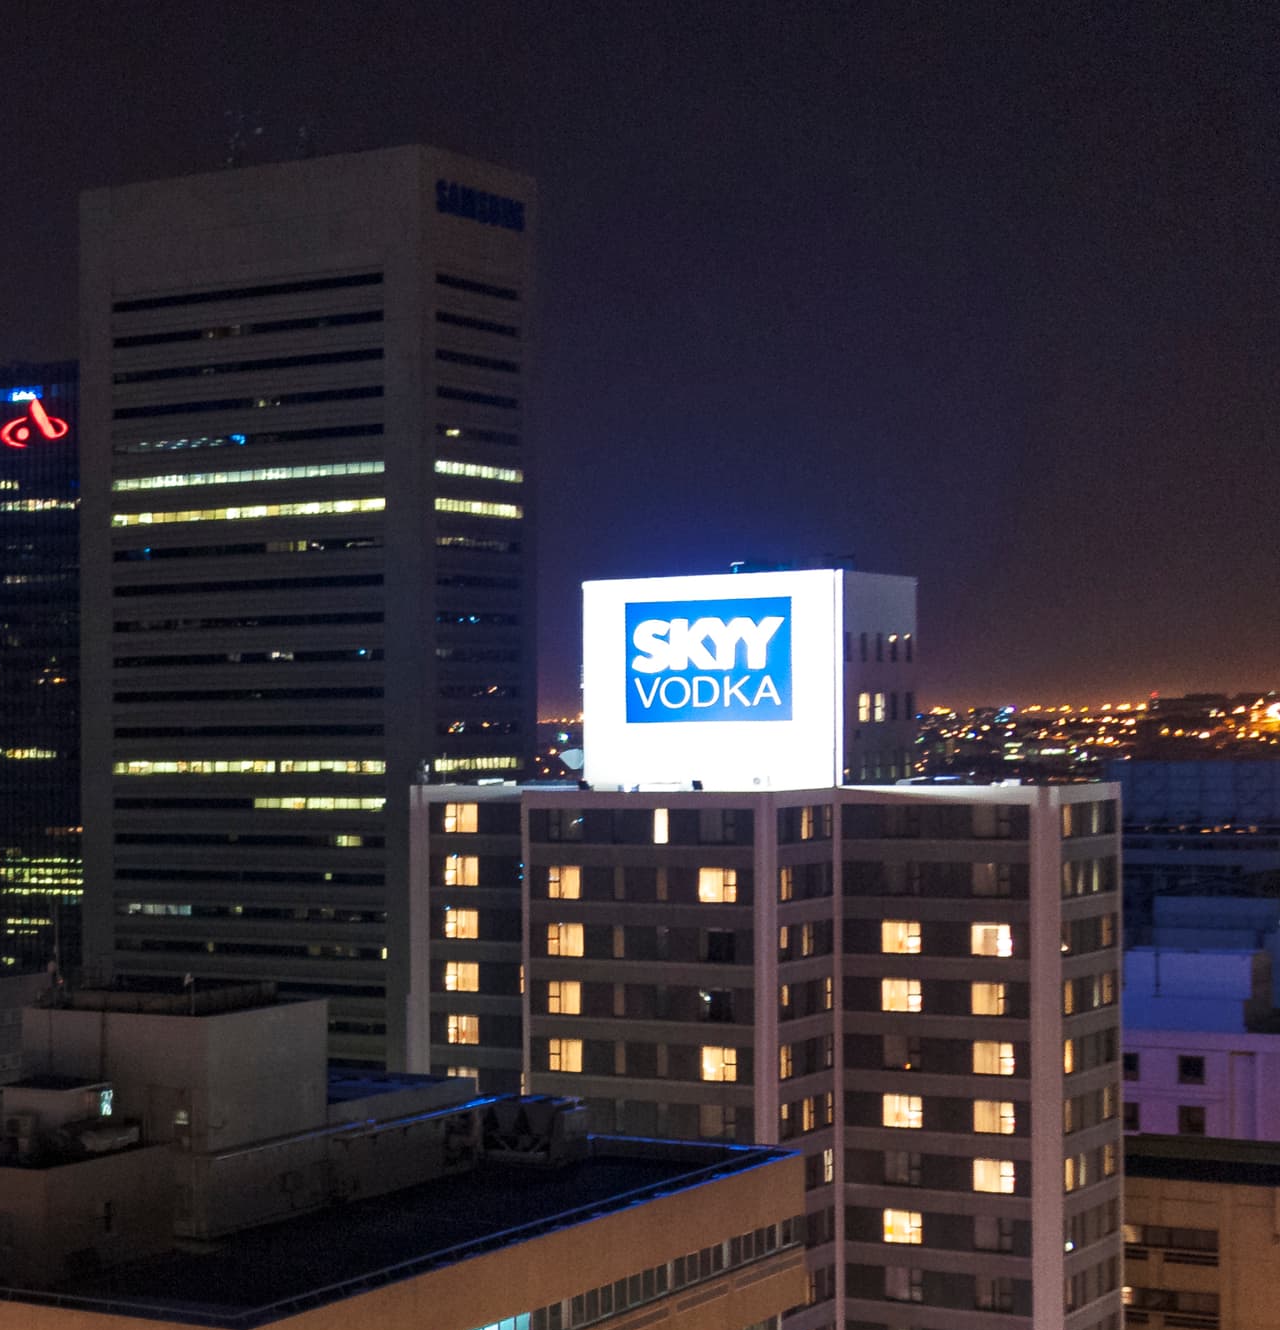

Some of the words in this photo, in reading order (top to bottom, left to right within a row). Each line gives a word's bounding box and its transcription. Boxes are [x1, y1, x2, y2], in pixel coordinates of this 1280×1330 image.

[435, 178, 525, 232] SAMSUNG
[631, 616, 785, 674] SKYY
[634, 675, 782, 709] VODKA
